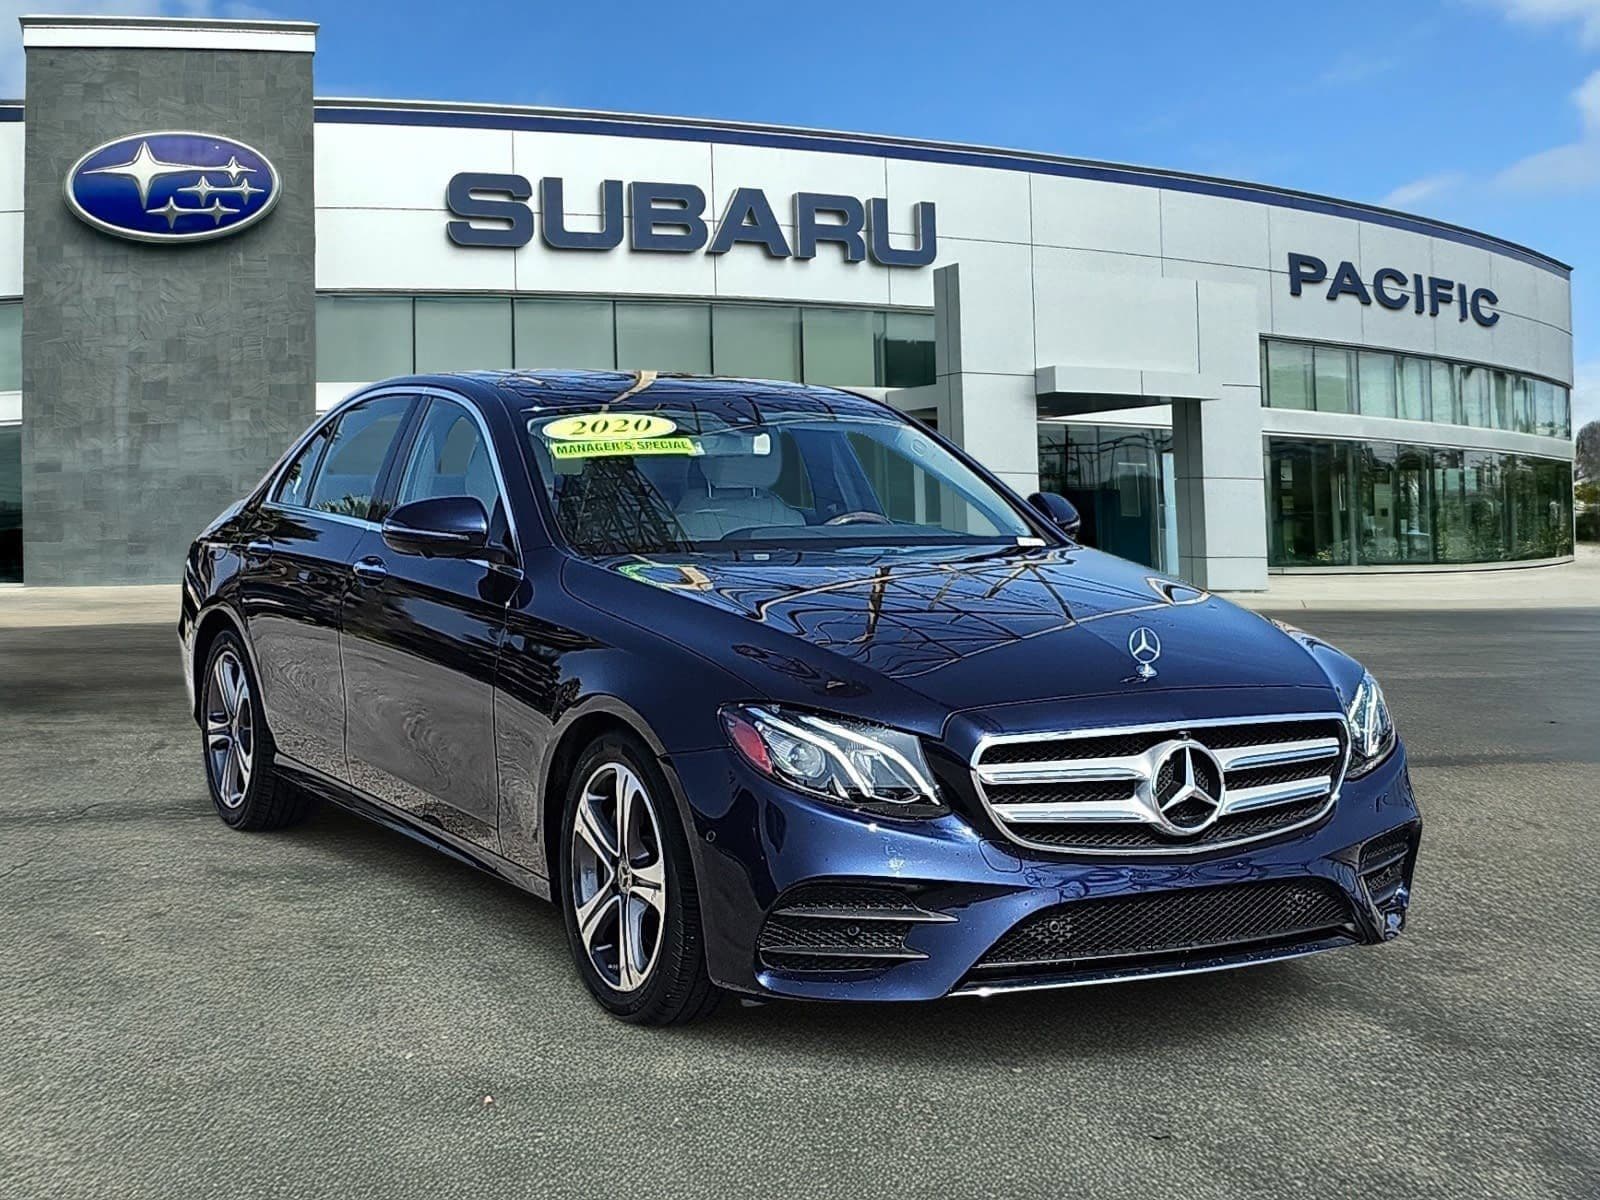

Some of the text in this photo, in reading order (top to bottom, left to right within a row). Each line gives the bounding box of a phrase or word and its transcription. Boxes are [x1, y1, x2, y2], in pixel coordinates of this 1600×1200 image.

[446, 172, 937, 267] SUBARU
[1288, 252, 1500, 327] PACIFIC
[556, 440, 690, 455] MANAGER'S SPECIAL
[569, 418, 652, 436] 2020
